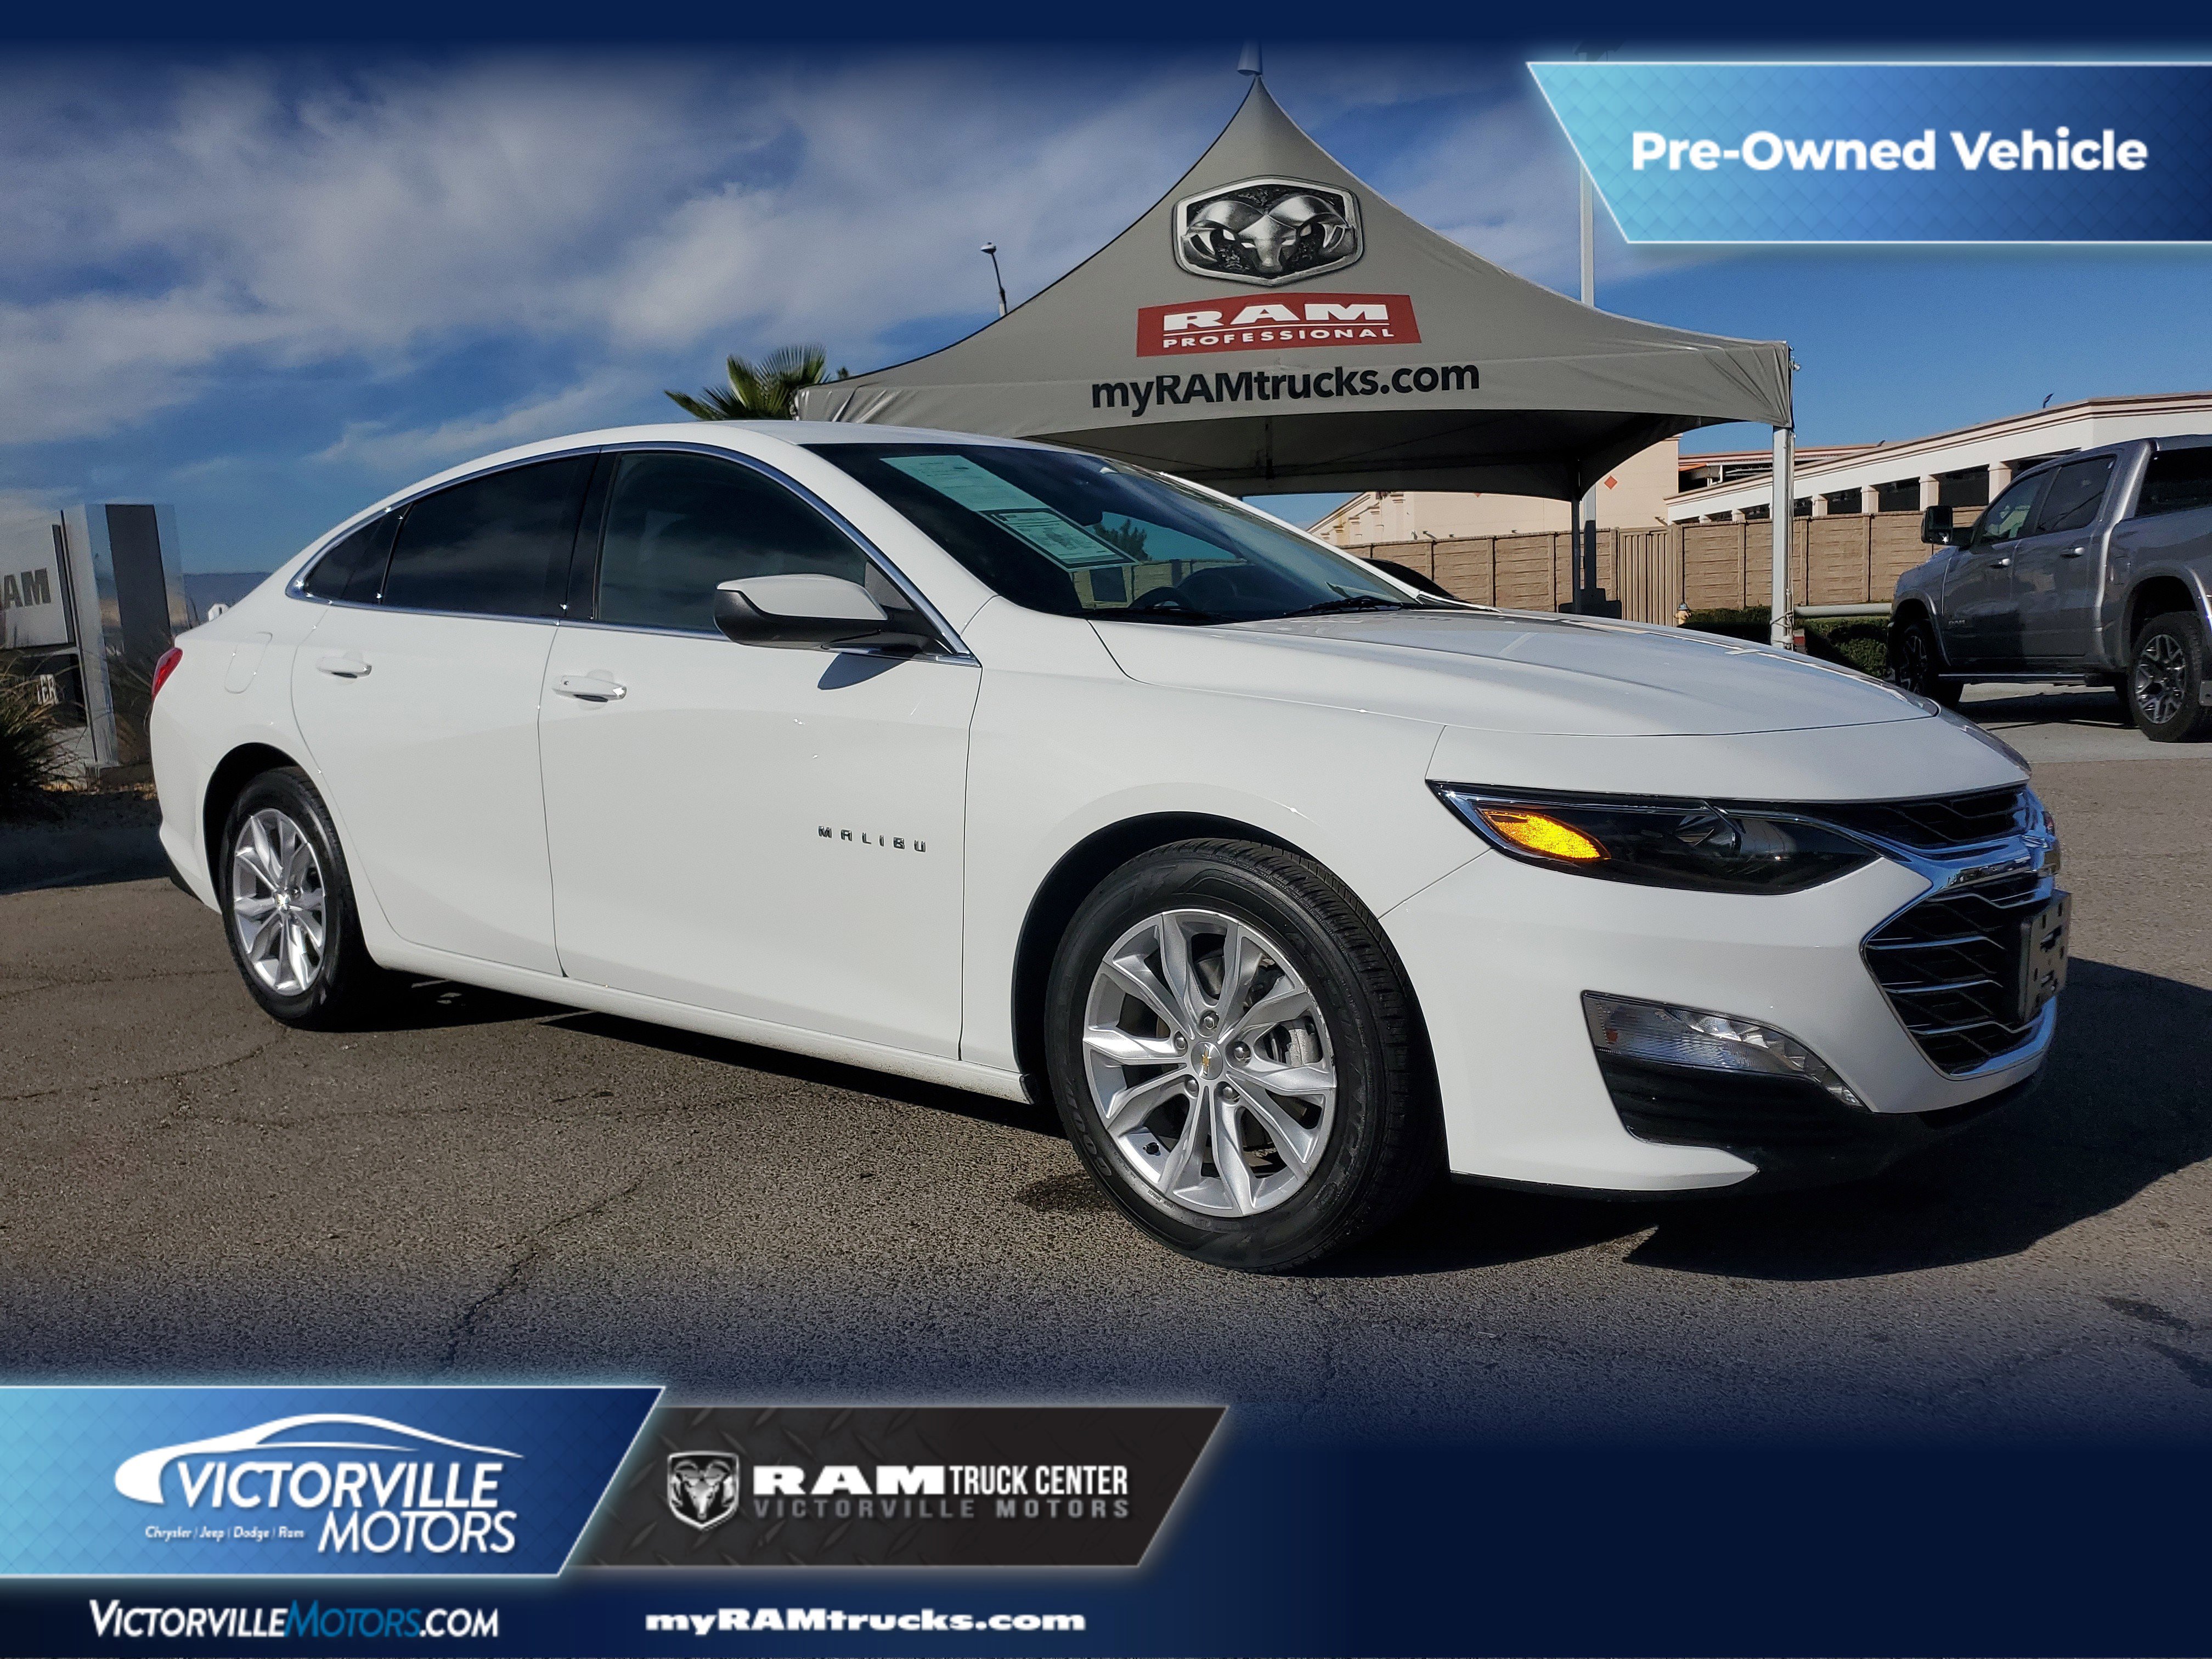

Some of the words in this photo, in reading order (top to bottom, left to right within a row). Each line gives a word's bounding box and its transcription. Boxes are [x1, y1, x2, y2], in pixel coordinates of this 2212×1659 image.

[1163, 303, 1390, 331] RAM
[1163, 328, 1395, 348] PROFESSIONAL
[1092, 364, 1480, 417] myRAMtrucks.com
[0, 568, 51, 609] AM
[817, 826, 927, 853] MALIBU
